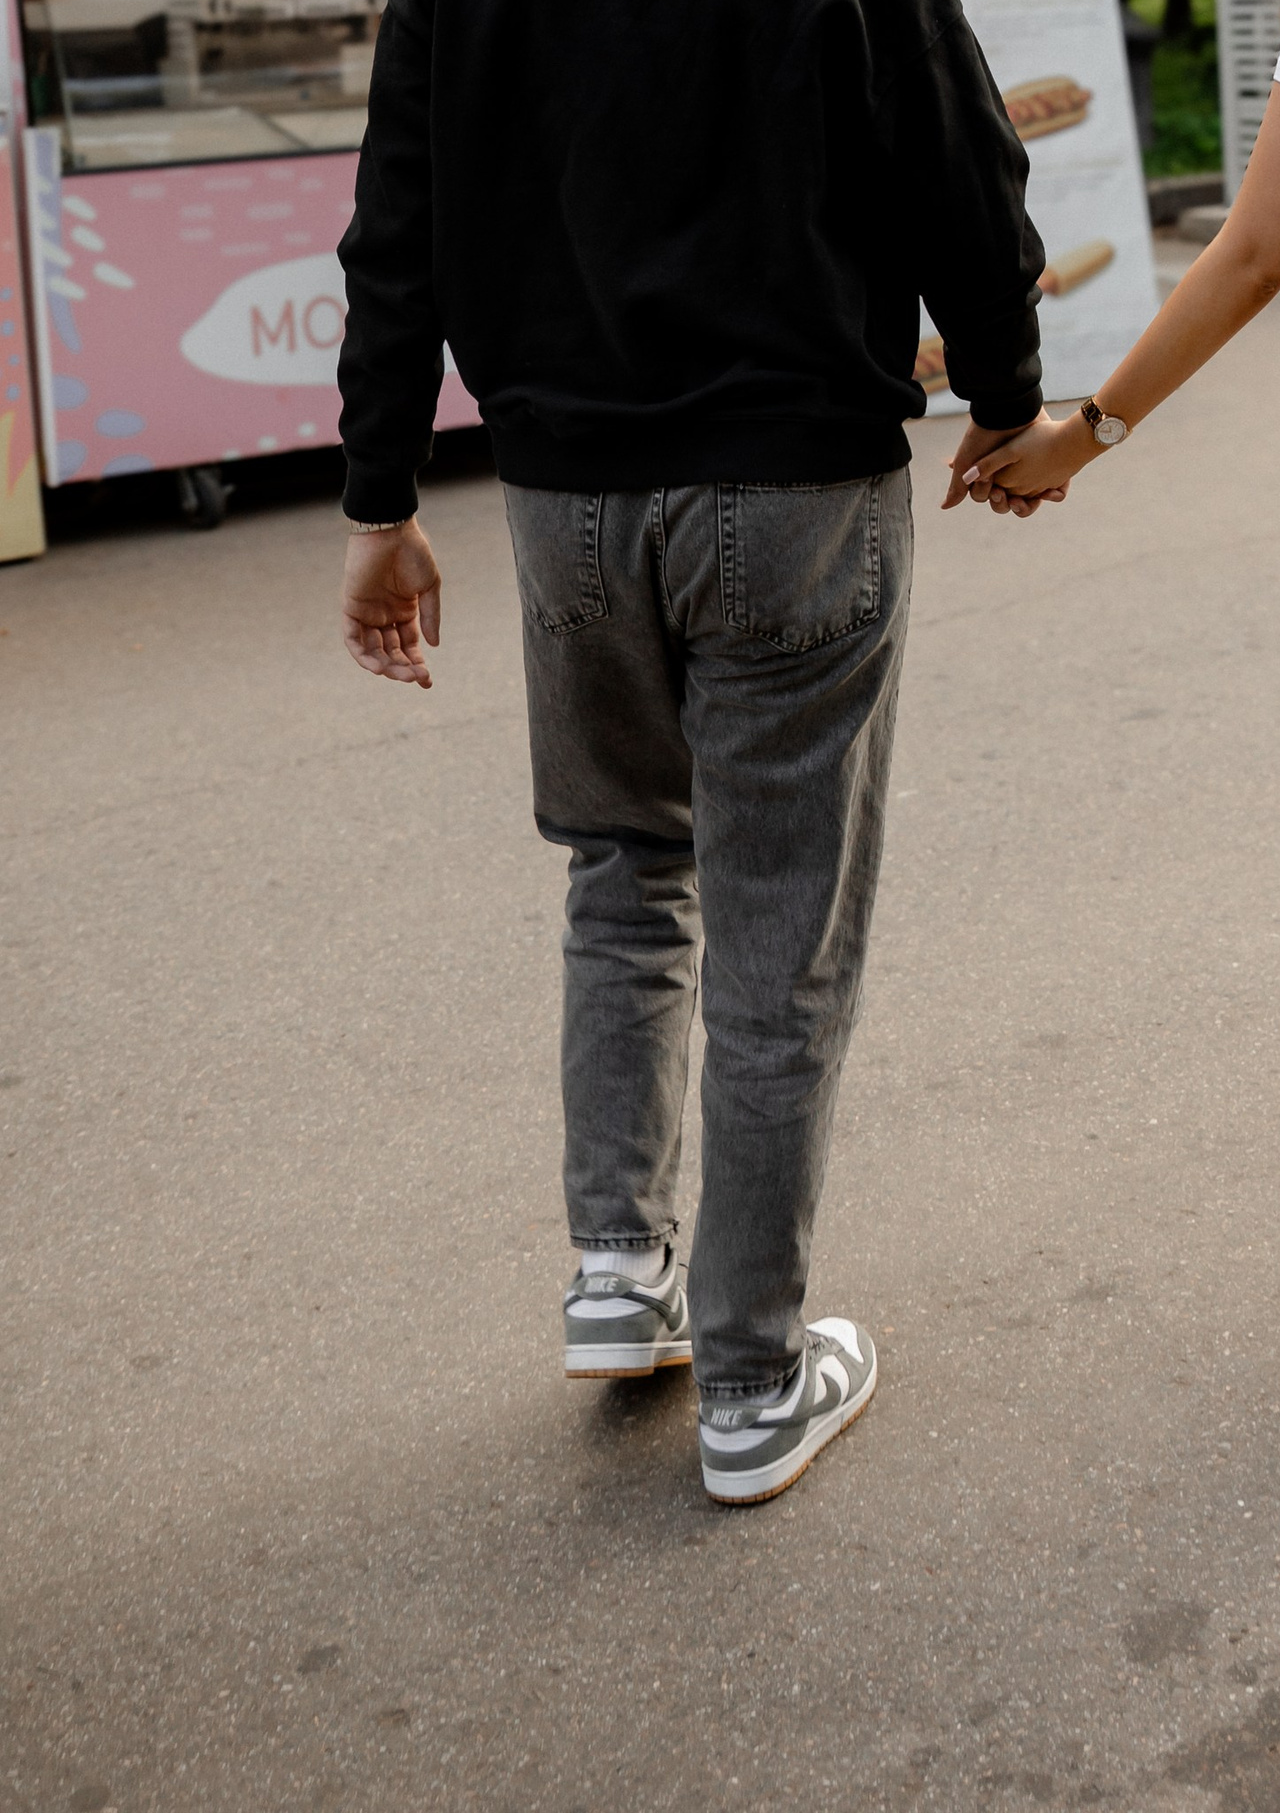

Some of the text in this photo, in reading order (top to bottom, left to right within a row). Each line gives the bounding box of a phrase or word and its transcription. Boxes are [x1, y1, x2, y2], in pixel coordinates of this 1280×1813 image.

[250, 295, 346, 360] МО
[584, 1276, 619, 1294] NIKE
[710, 1407, 743, 1427] NIKE
